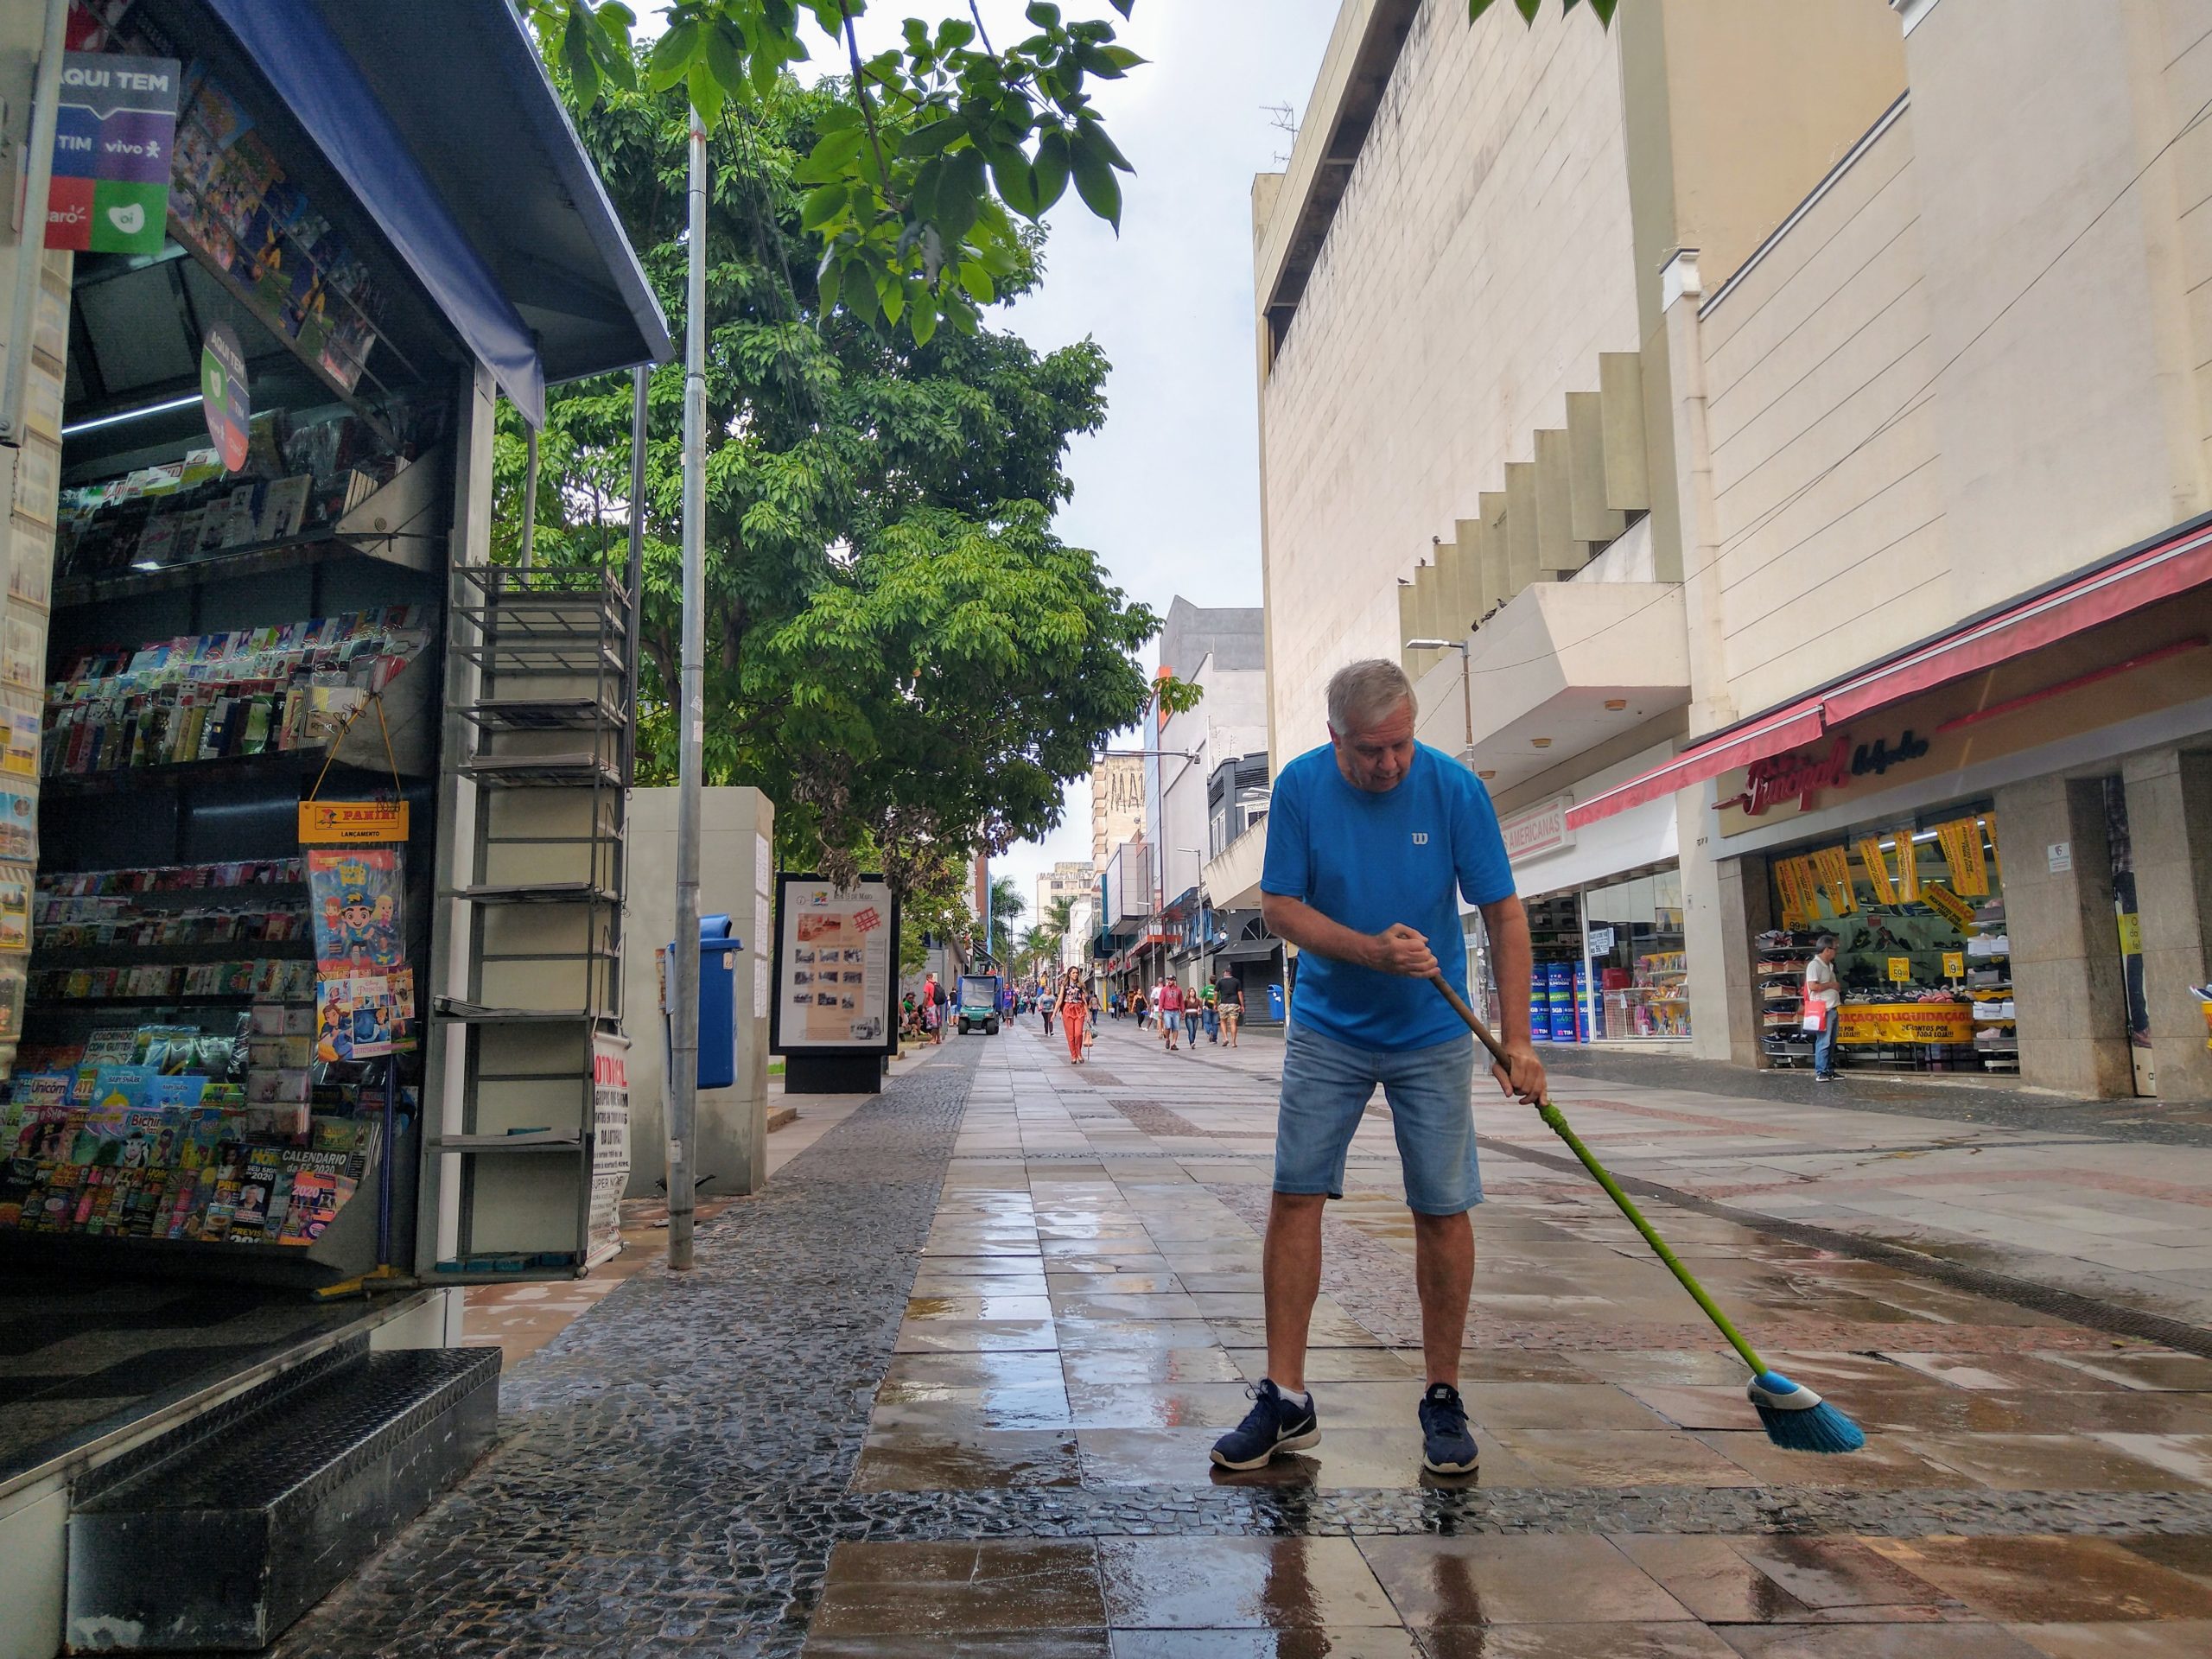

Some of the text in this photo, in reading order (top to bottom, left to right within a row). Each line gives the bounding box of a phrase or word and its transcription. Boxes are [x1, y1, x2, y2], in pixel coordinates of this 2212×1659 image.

[117, 71, 168, 92] TEM
[58, 136, 92, 151] TIM
[105, 140, 143, 155] vivo
[211, 331, 245, 378] AQUI TEM
[342, 810, 397, 821] PANINI
[1509, 813, 1560, 849] AMERICANAS
[1411, 832, 1428, 845] W
[87, 1042, 105, 1052] COM
[282, 1150, 346, 1166] CALENDÁRIO
[251, 1172, 274, 1181] 2020
[314, 1166, 335, 1175] 2020
[291, 1186, 320, 1199] 2020
